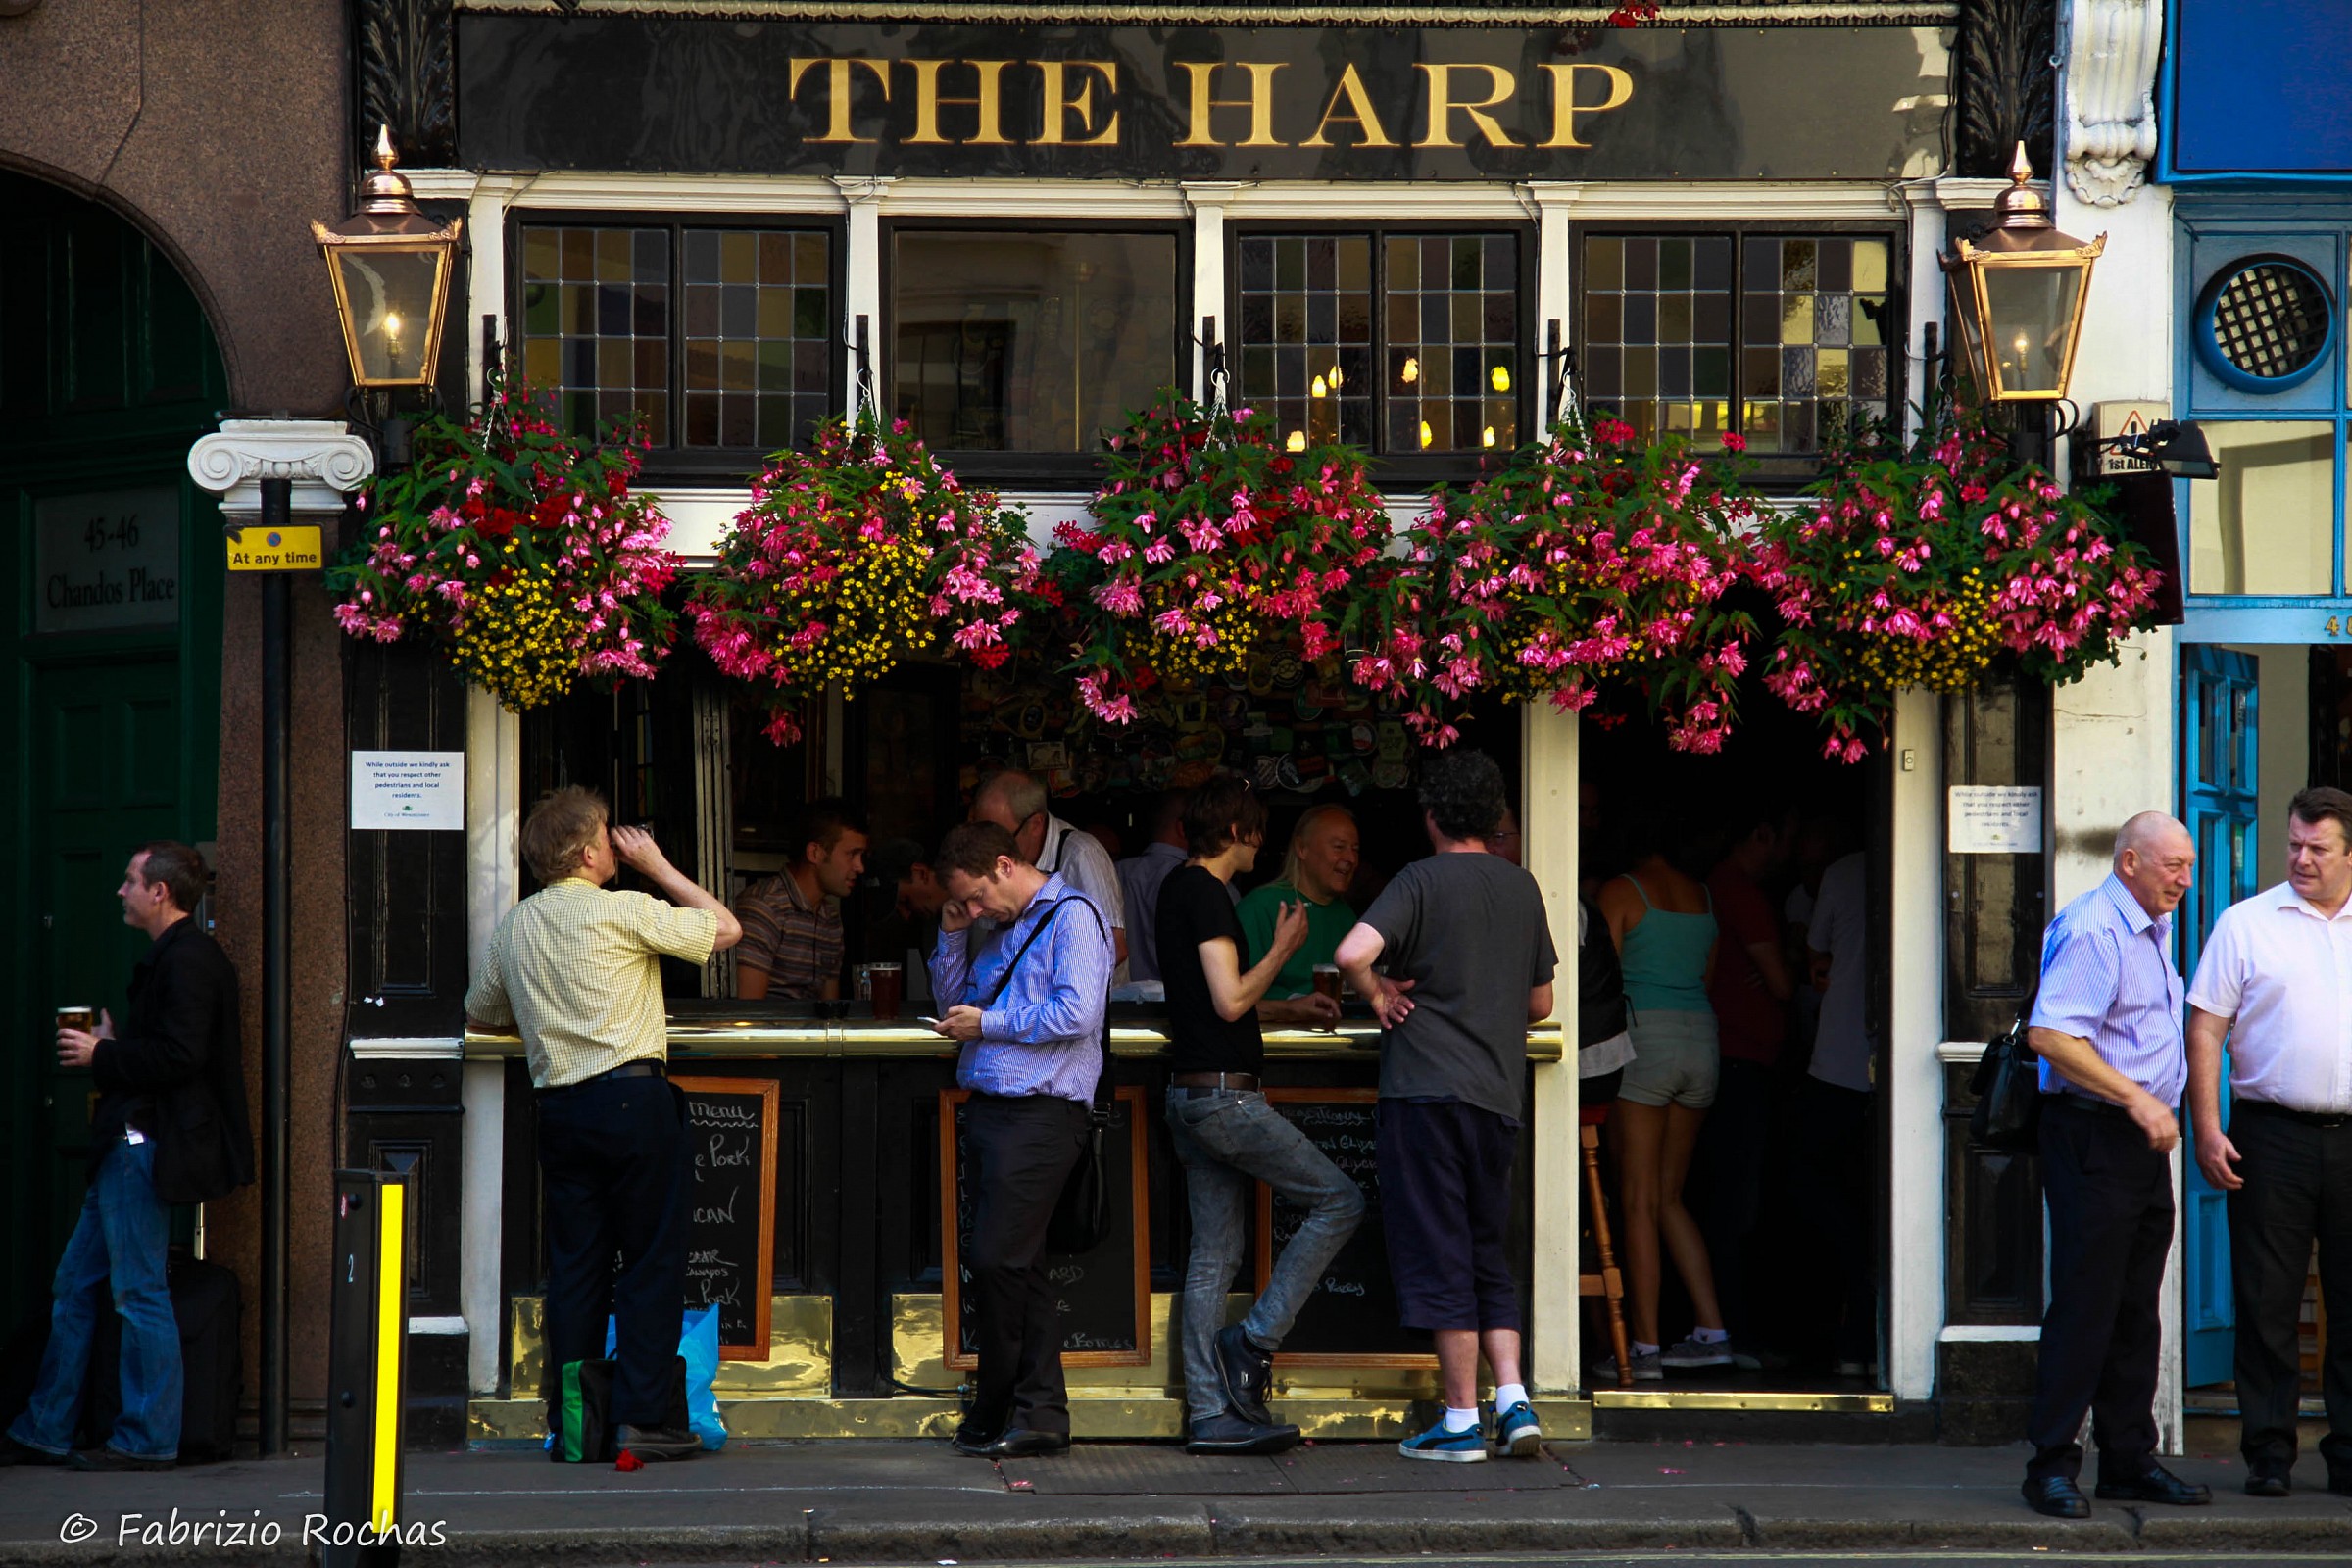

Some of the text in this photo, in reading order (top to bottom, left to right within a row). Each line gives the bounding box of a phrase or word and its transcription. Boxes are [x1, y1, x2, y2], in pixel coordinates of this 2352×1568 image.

[789, 57, 1635, 149] THE HARP
[2108, 458, 2158, 470] 1st ALER
[84, 514, 139, 553] 45-46
[232, 551, 317, 566] At any time
[47, 565, 175, 609] Chandos Place
